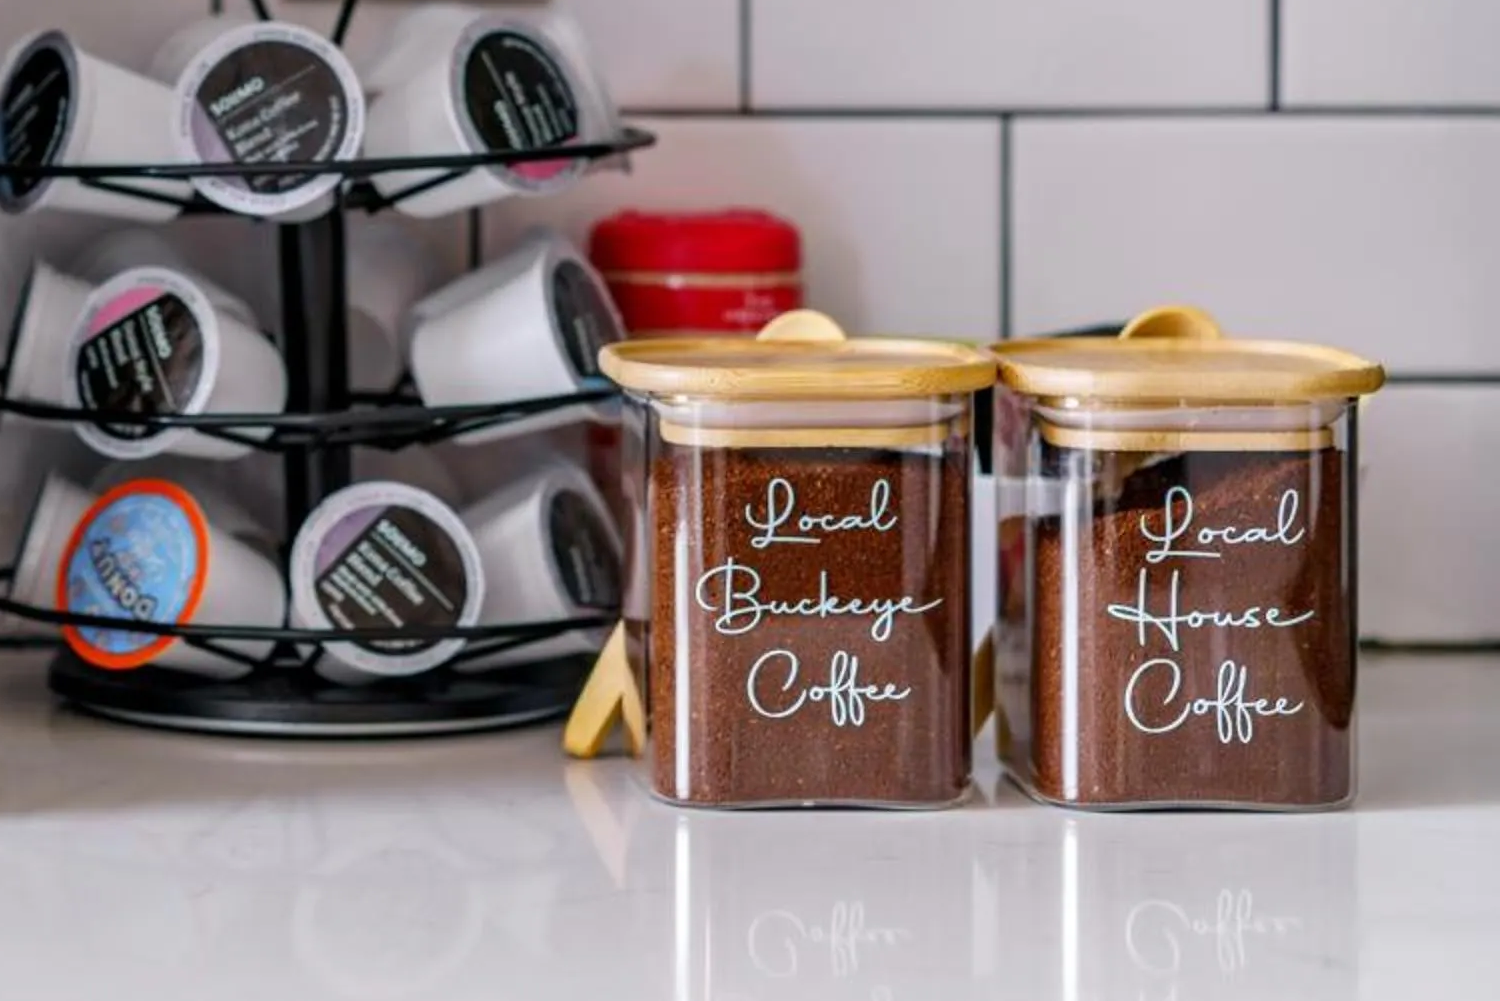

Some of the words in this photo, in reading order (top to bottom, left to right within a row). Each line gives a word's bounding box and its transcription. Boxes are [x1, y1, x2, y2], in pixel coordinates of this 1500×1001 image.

[745, 478, 898, 549] Local
[1139, 486, 1306, 563] Local
[695, 557, 944, 641] Buckeye
[1107, 567, 1315, 651] House
[747, 650, 912, 727] Coffee
[1124, 658, 1305, 743] Coffee
